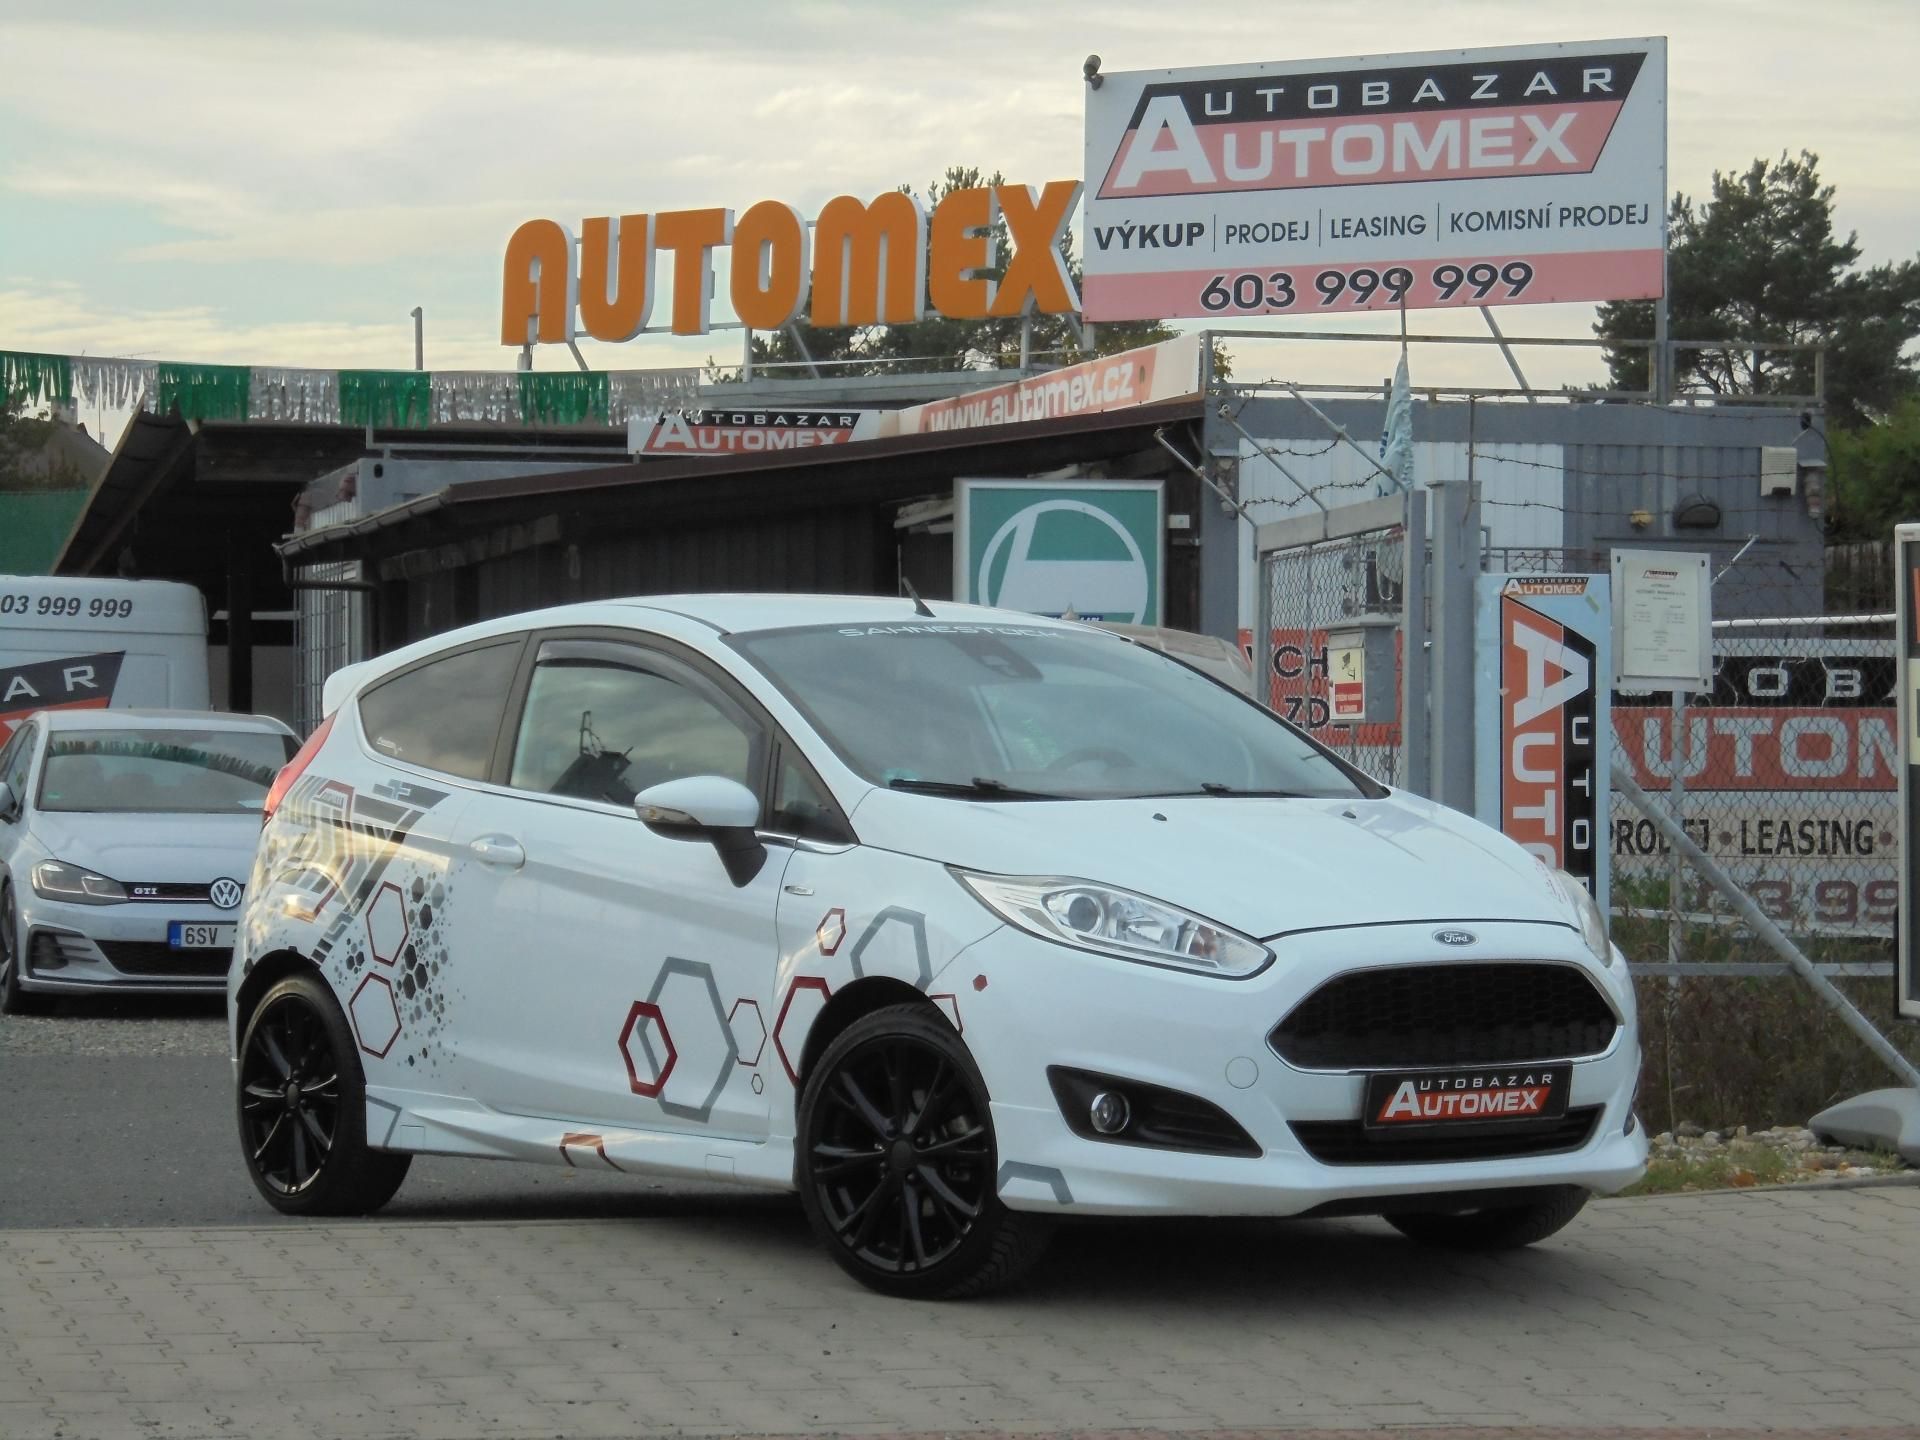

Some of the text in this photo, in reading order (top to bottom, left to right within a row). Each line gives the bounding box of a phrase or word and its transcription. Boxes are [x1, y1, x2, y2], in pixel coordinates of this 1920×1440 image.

[1112, 94, 1579, 190] AUTOMEX
[1094, 201, 1650, 252] VÝKUP PRODEJ LEASING KOMISNÍ PRODEJ
[501, 180, 1084, 347] AUTOMEX
[1200, 261, 1534, 311] 603 999 999
[930, 361, 1135, 432] www.automex.cz
[652, 412, 840, 451] AUTOMEX
[1504, 578, 1584, 595] AUTOMEX
[37, 595, 82, 617] 999
[88, 597, 133, 619] 999
[1740, 818, 1875, 857] LEASING
[133, 886, 159, 896] GTI
[184, 926, 219, 946] 6SV
[1383, 1080, 1540, 1119] AUTOMEX
